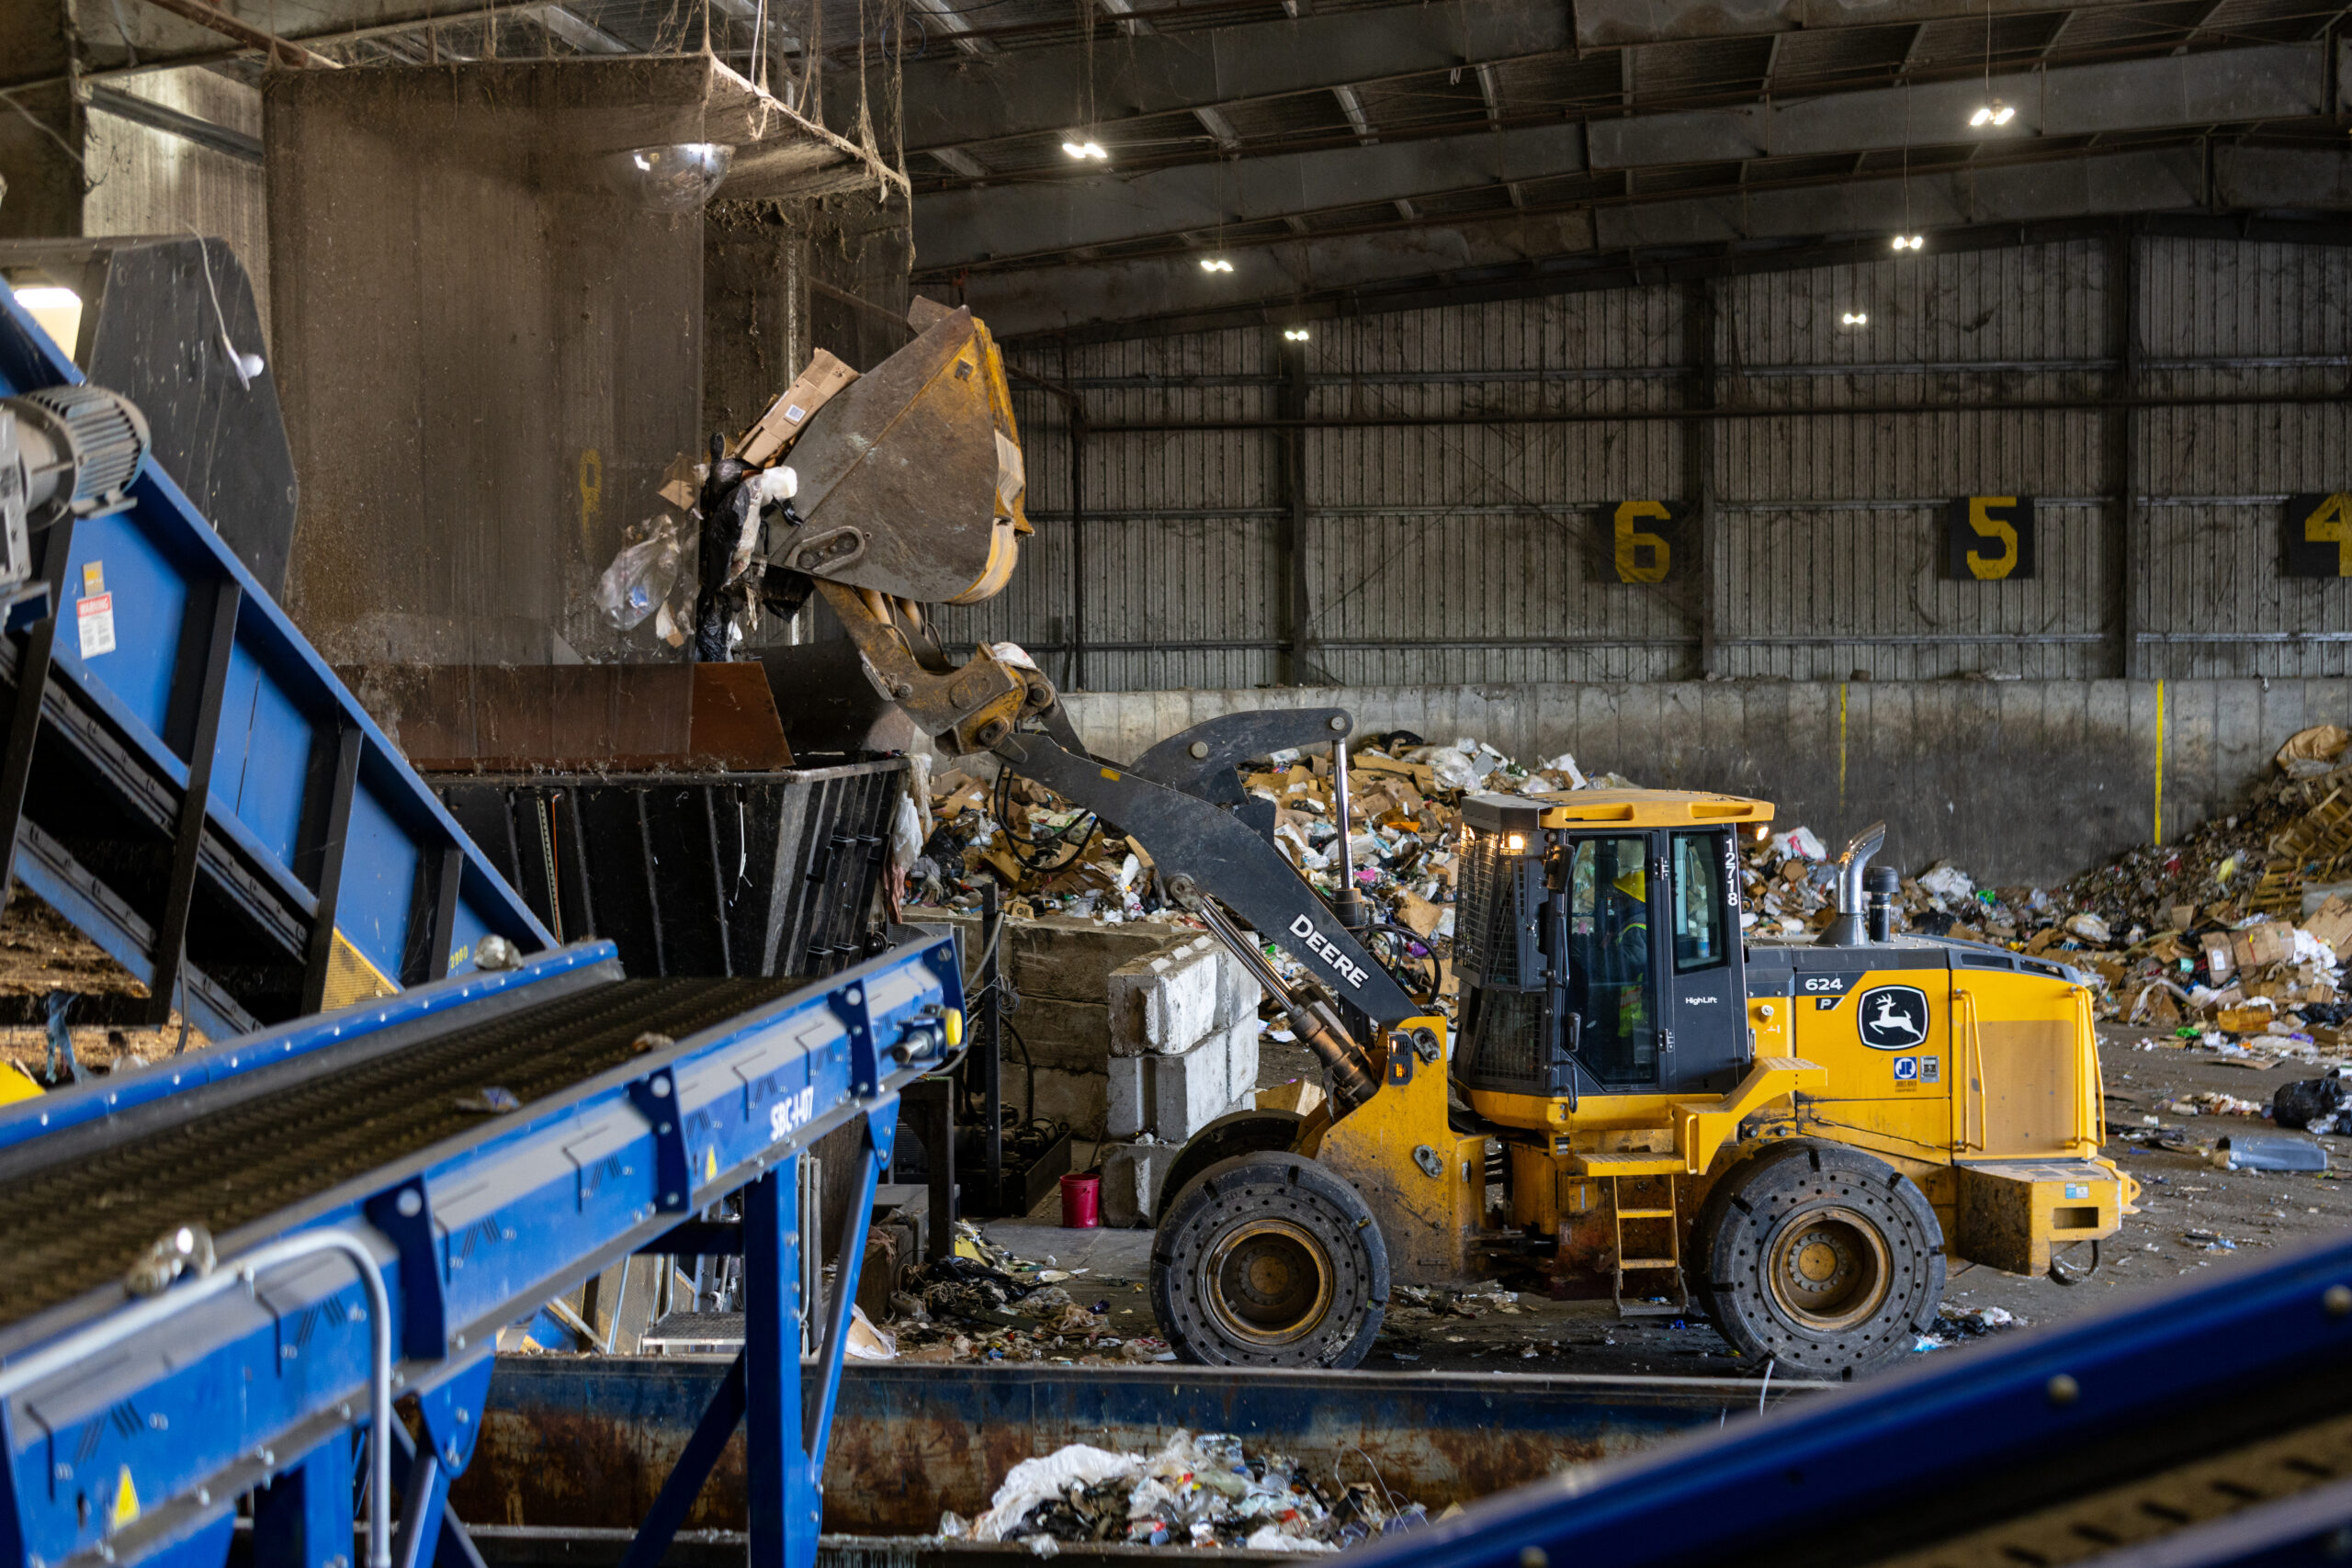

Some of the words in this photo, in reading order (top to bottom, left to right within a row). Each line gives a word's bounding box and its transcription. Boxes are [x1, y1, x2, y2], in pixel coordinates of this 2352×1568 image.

[1614, 501, 1670, 582] 6
[1967, 497, 2018, 580] 5
[2304, 492, 2352, 577] 4
[1725, 839, 1738, 907] 12718
[1289, 914, 1369, 989] DEERE
[1805, 978, 1843, 991] 624
[1820, 999, 1831, 1009] P
